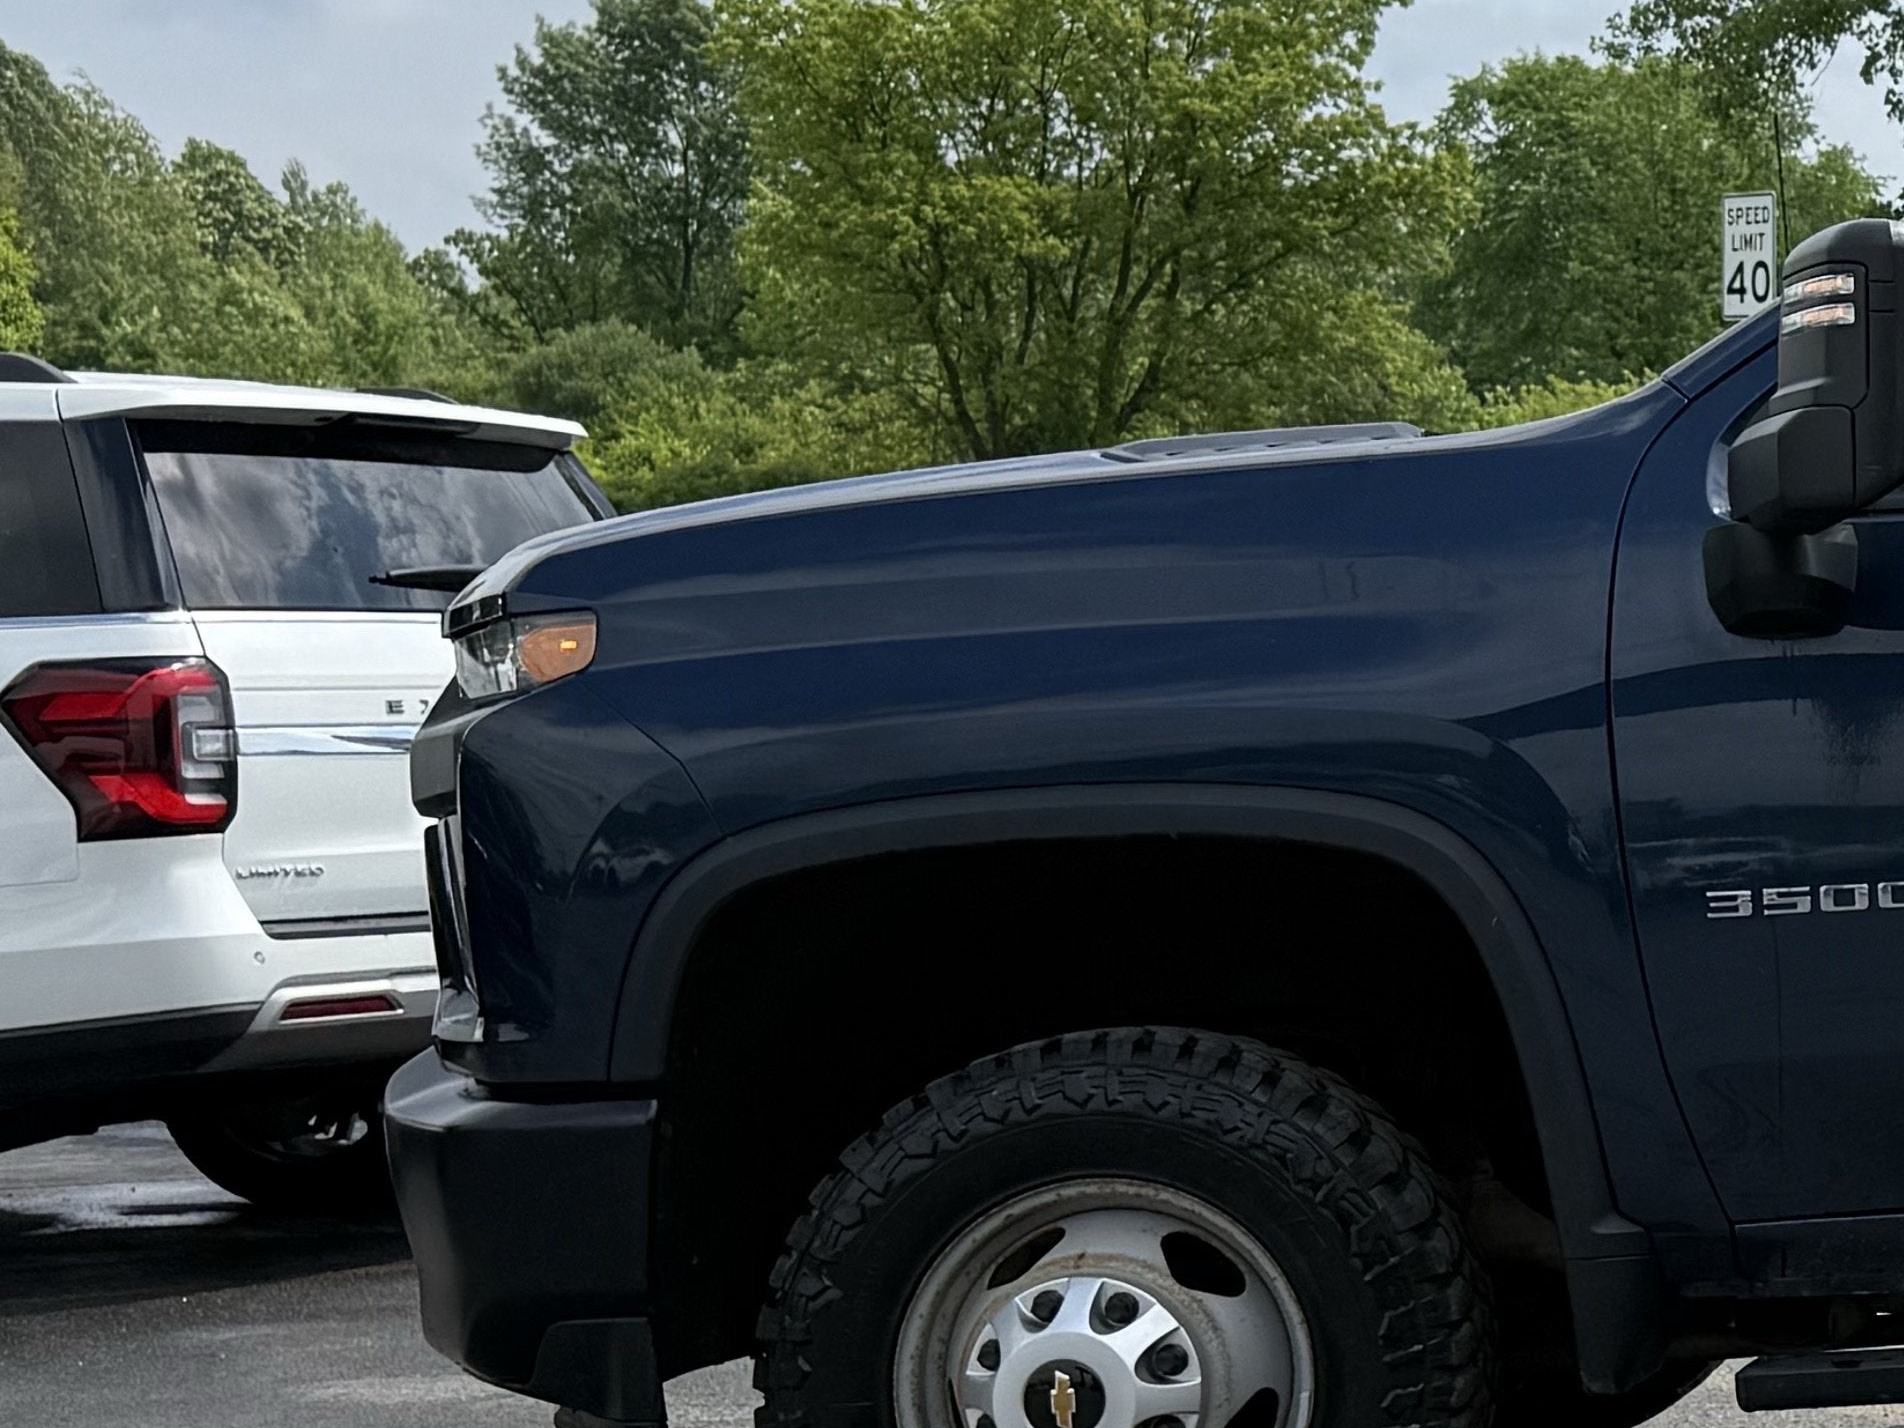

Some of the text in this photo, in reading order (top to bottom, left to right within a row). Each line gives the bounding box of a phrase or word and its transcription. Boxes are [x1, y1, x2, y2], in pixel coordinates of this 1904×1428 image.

[1727, 206, 1770, 225] SPEED
[1731, 233, 1766, 252] LIMIT
[1727, 260, 1770, 303] 40
